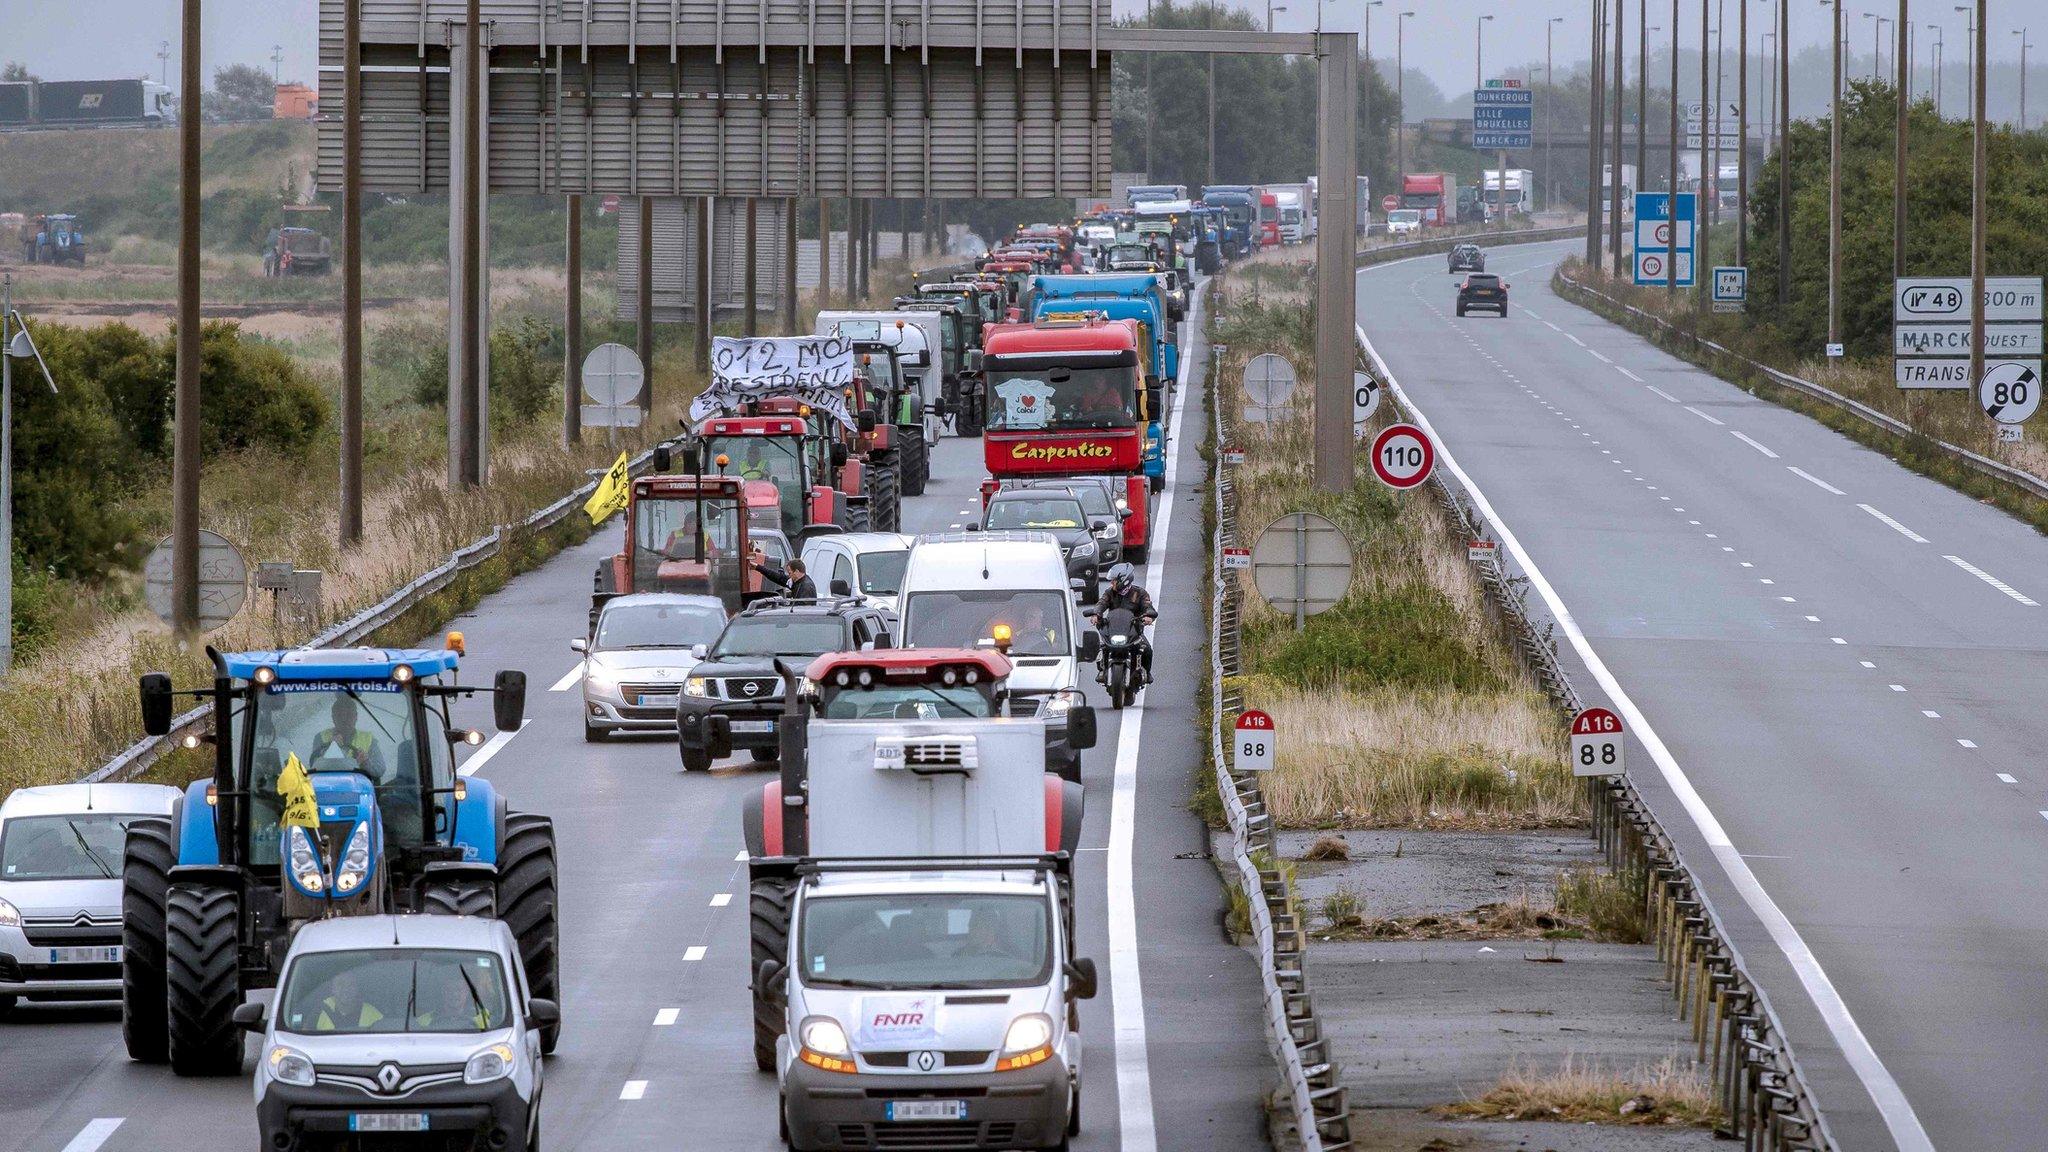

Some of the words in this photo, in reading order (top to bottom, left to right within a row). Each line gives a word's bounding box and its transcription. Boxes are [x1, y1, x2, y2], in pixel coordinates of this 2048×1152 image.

[1477, 93, 1529, 101] DUNKERQUE
[1477, 110, 1502, 118] LILLE
[1477, 120, 1528, 128] BRUXELLES
[1933, 293, 1957, 307] 48
[1903, 332, 1971, 347] MARCK
[1994, 382, 2028, 405] 80
[1011, 442, 1113, 463] Carpentier
[1384, 446, 1422, 467] 110
[1245, 716, 1253, 727] A
[1254, 716, 1266, 727] 16
[1580, 717, 1591, 732] A
[1595, 716, 1614, 731] 16
[1243, 742, 1265, 757] 88
[1580, 743, 1616, 766] 88
[873, 1013, 924, 1026] FNTR
